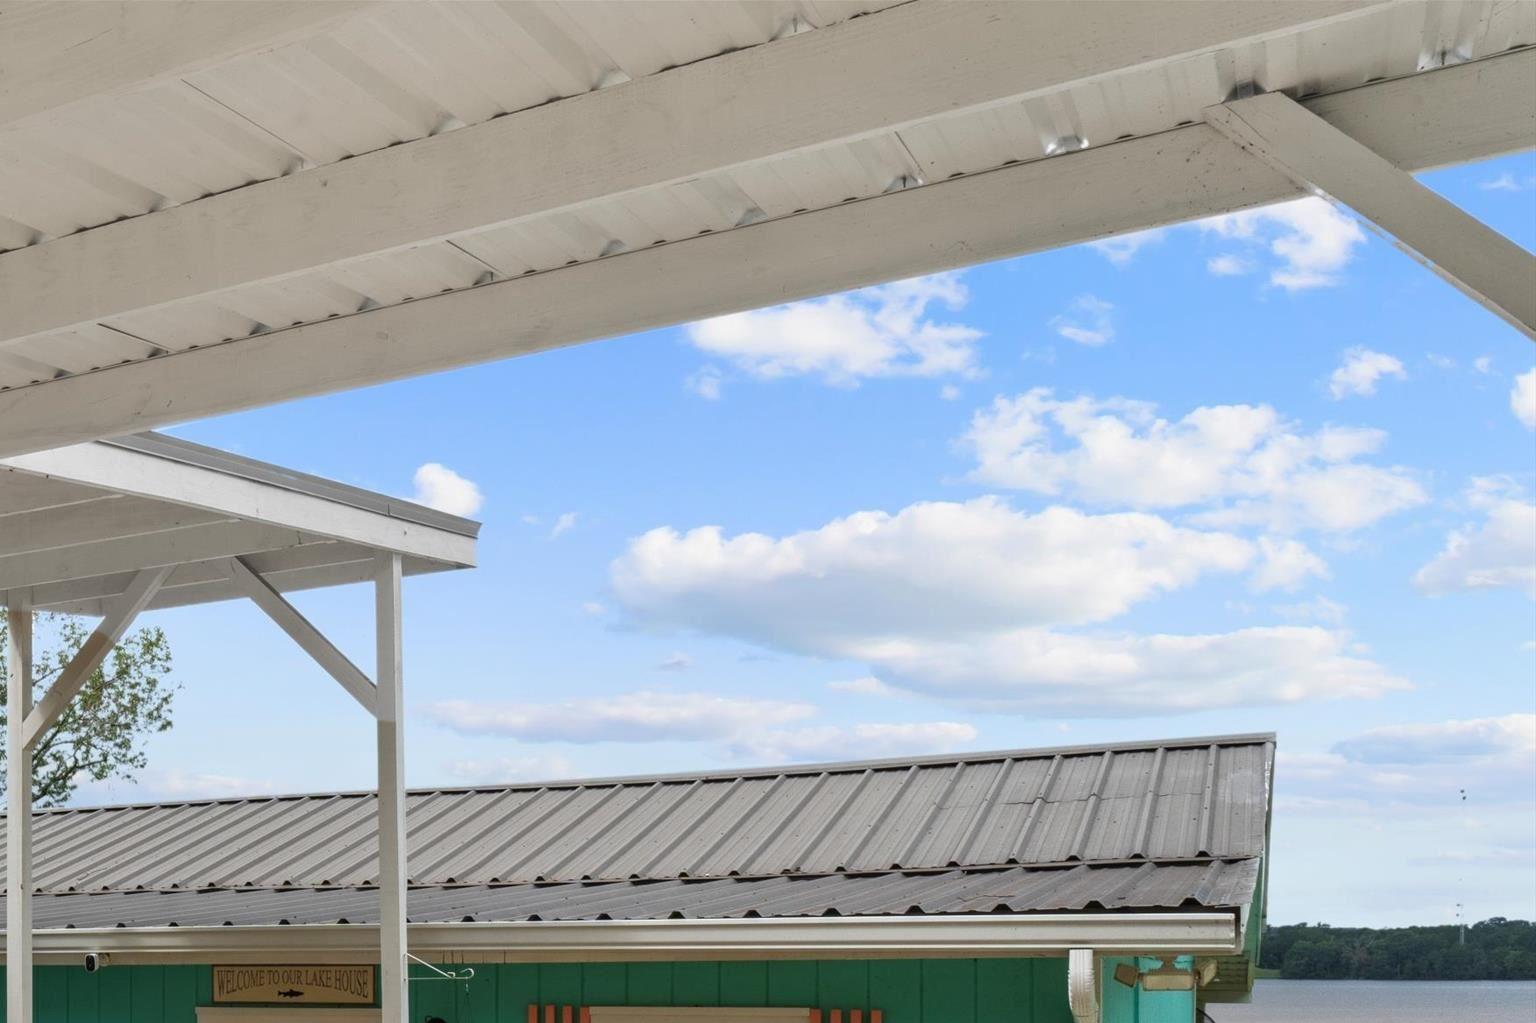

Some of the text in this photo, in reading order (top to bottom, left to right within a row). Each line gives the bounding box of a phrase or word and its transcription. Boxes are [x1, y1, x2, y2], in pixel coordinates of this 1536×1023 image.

[216, 969, 369, 998] WELCOME TO OUR LAKE HOUSE
